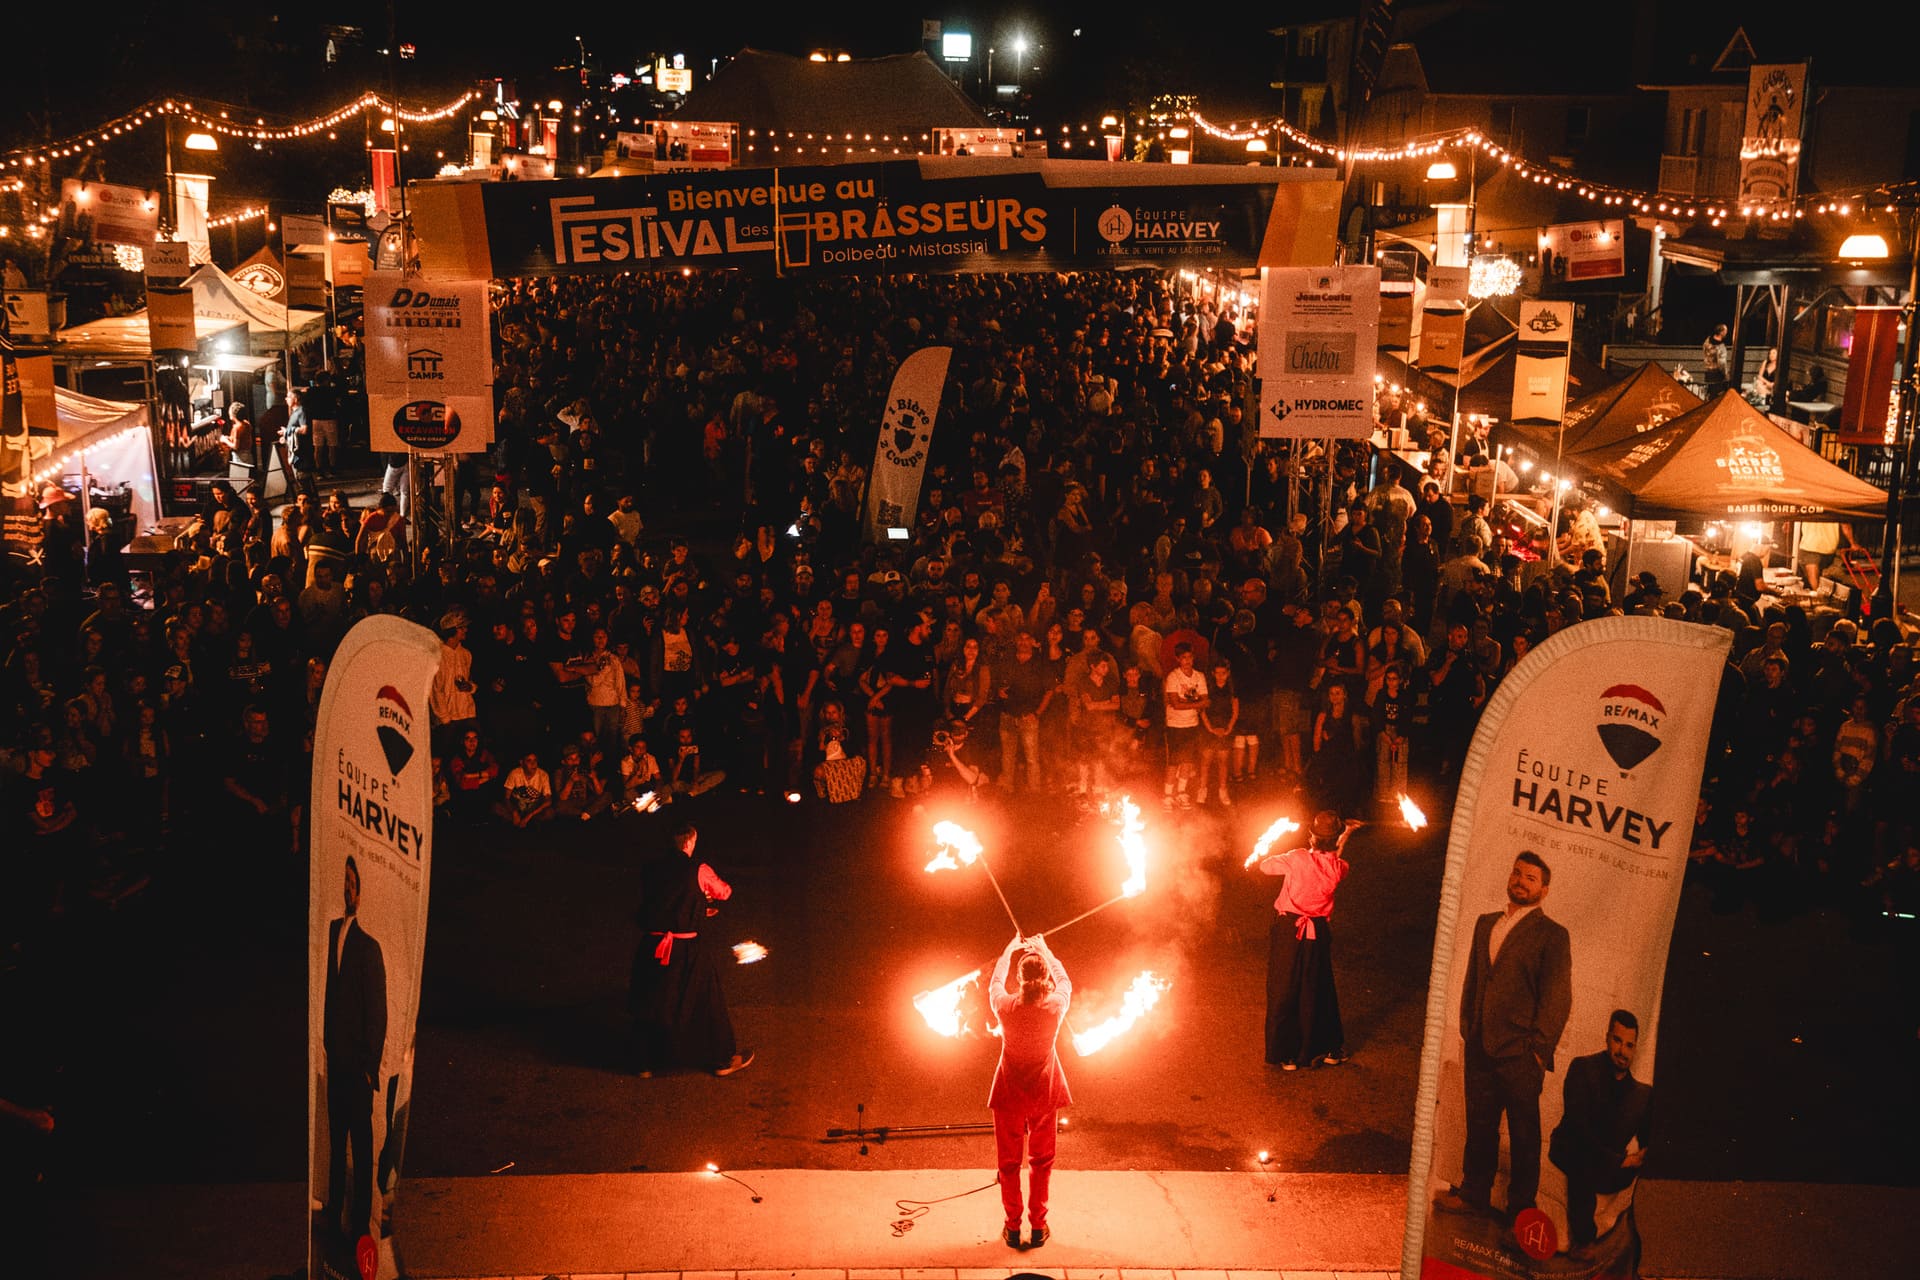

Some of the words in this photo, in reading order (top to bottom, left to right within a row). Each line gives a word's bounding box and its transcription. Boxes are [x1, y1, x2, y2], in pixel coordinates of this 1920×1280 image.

[667, 183, 826, 212] Bienvenue
[836, 179, 875, 200] au
[1135, 207, 1185, 220] ÉQUIPE
[550, 196, 774, 264] FESTIVAL
[740, 223, 769, 238] des
[814, 198, 1048, 250] BRASSEURS
[1135, 222, 1220, 239] HARVEY
[823, 246, 897, 263] Dolbeau
[909, 238, 989, 258] Mistassini
[408, 372, 444, 380] CAMPS
[896, 398, 930, 425] Bière
[1295, 399, 1363, 411] HYDROMEC
[886, 449, 924, 468] Coups
[1716, 458, 1772, 468] BARBE
[1730, 465, 1783, 476] NOIRE
[1727, 504, 1824, 514] BARBENOIRE.COM
[379, 706, 411, 735] RE/MAX
[1604, 704, 1660, 730] RE/MAX
[339, 748, 389, 802] ÉQUIPE
[1517, 749, 1609, 796] ÉQUIPE
[338, 778, 424, 862] HARVEY
[1512, 778, 1673, 850] HARVEY
[1508, 826, 1519, 836] LA
[1550, 839, 1561, 850] DE
[1567, 843, 1594, 859] VENTE
